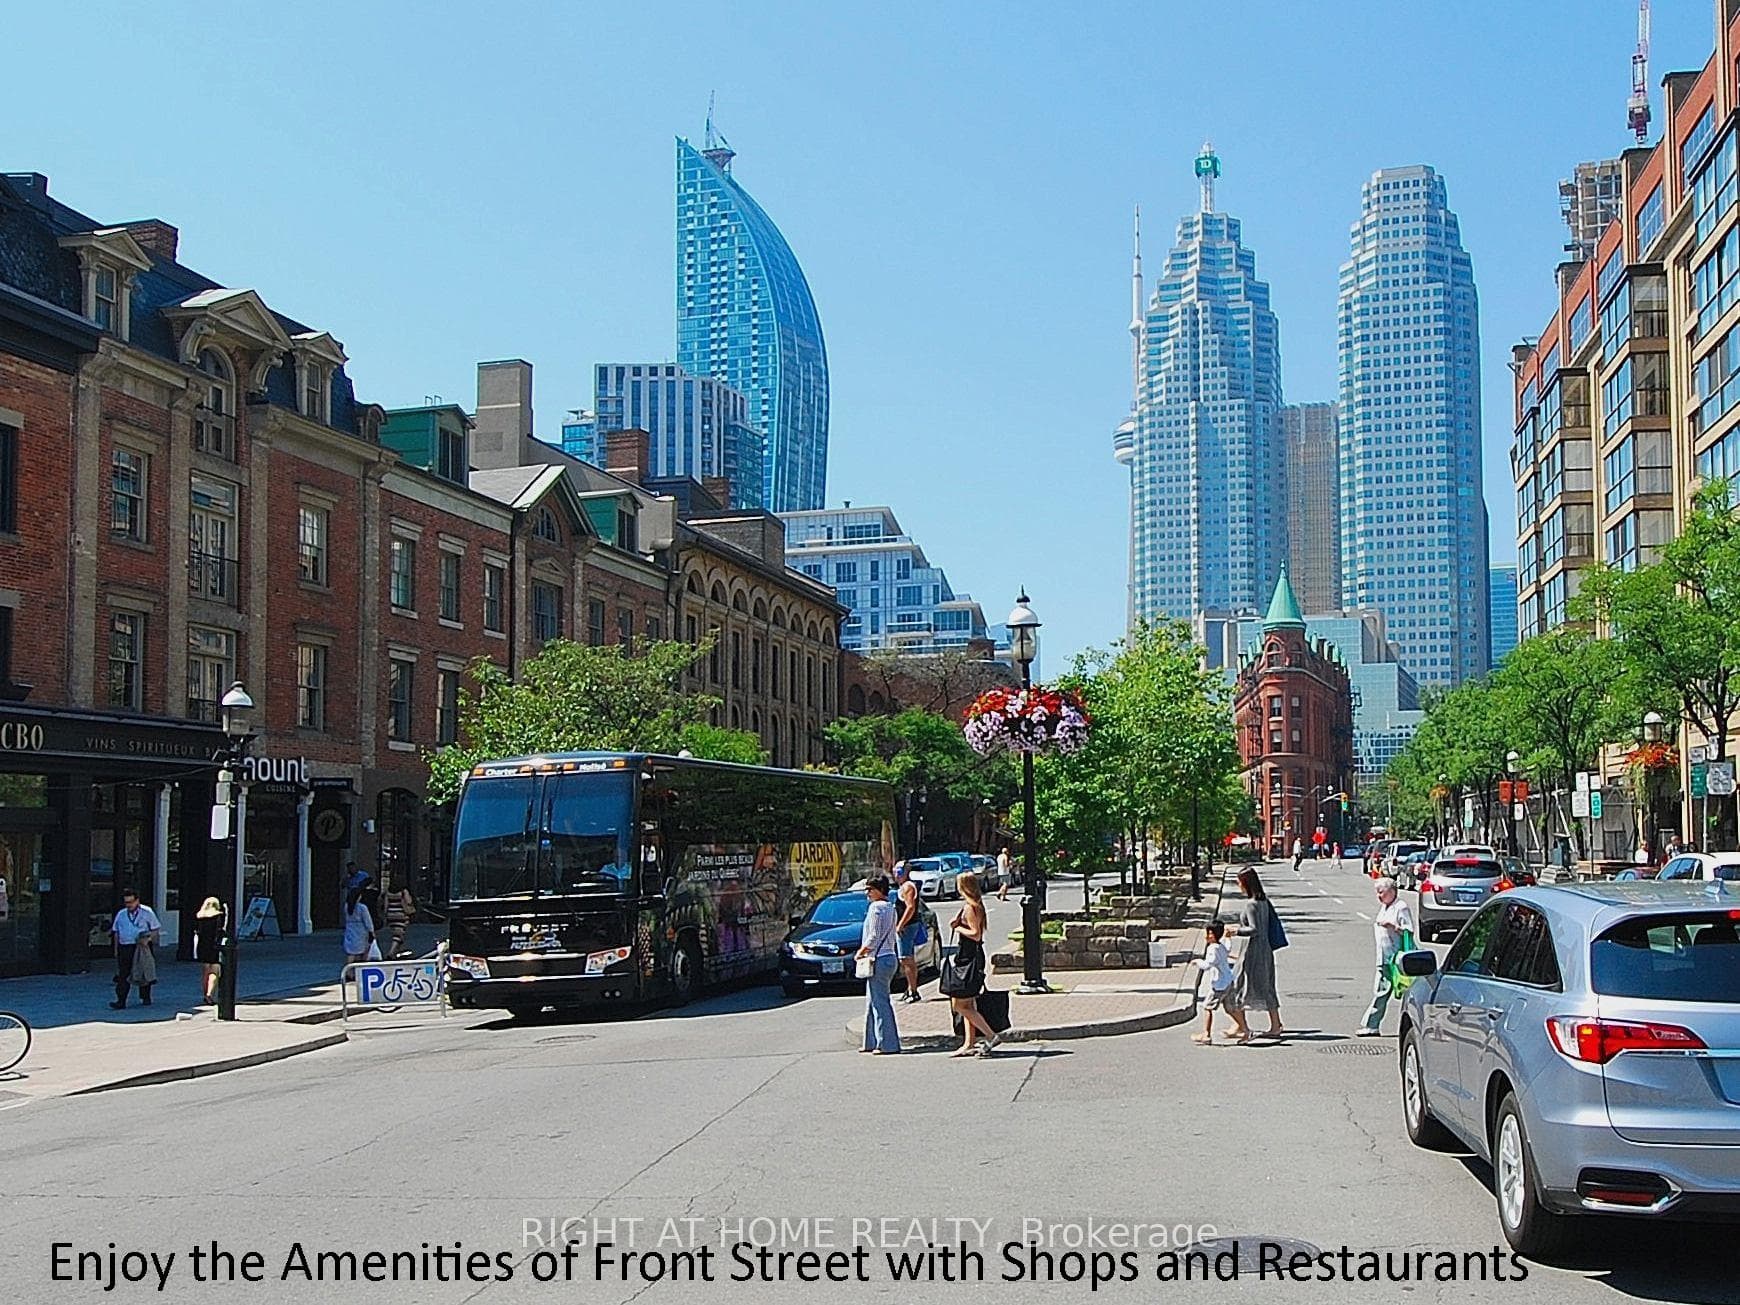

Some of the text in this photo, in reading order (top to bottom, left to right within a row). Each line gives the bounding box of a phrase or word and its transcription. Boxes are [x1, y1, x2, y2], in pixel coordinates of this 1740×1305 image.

[1, 722, 44, 751] CBO
[86, 737, 117, 751] VINS
[128, 740, 195, 756] SPIRITUEUX
[265, 783, 296, 793] CUISINE
[795, 842, 834, 864] JARDIN
[799, 864, 834, 882] SCULLION
